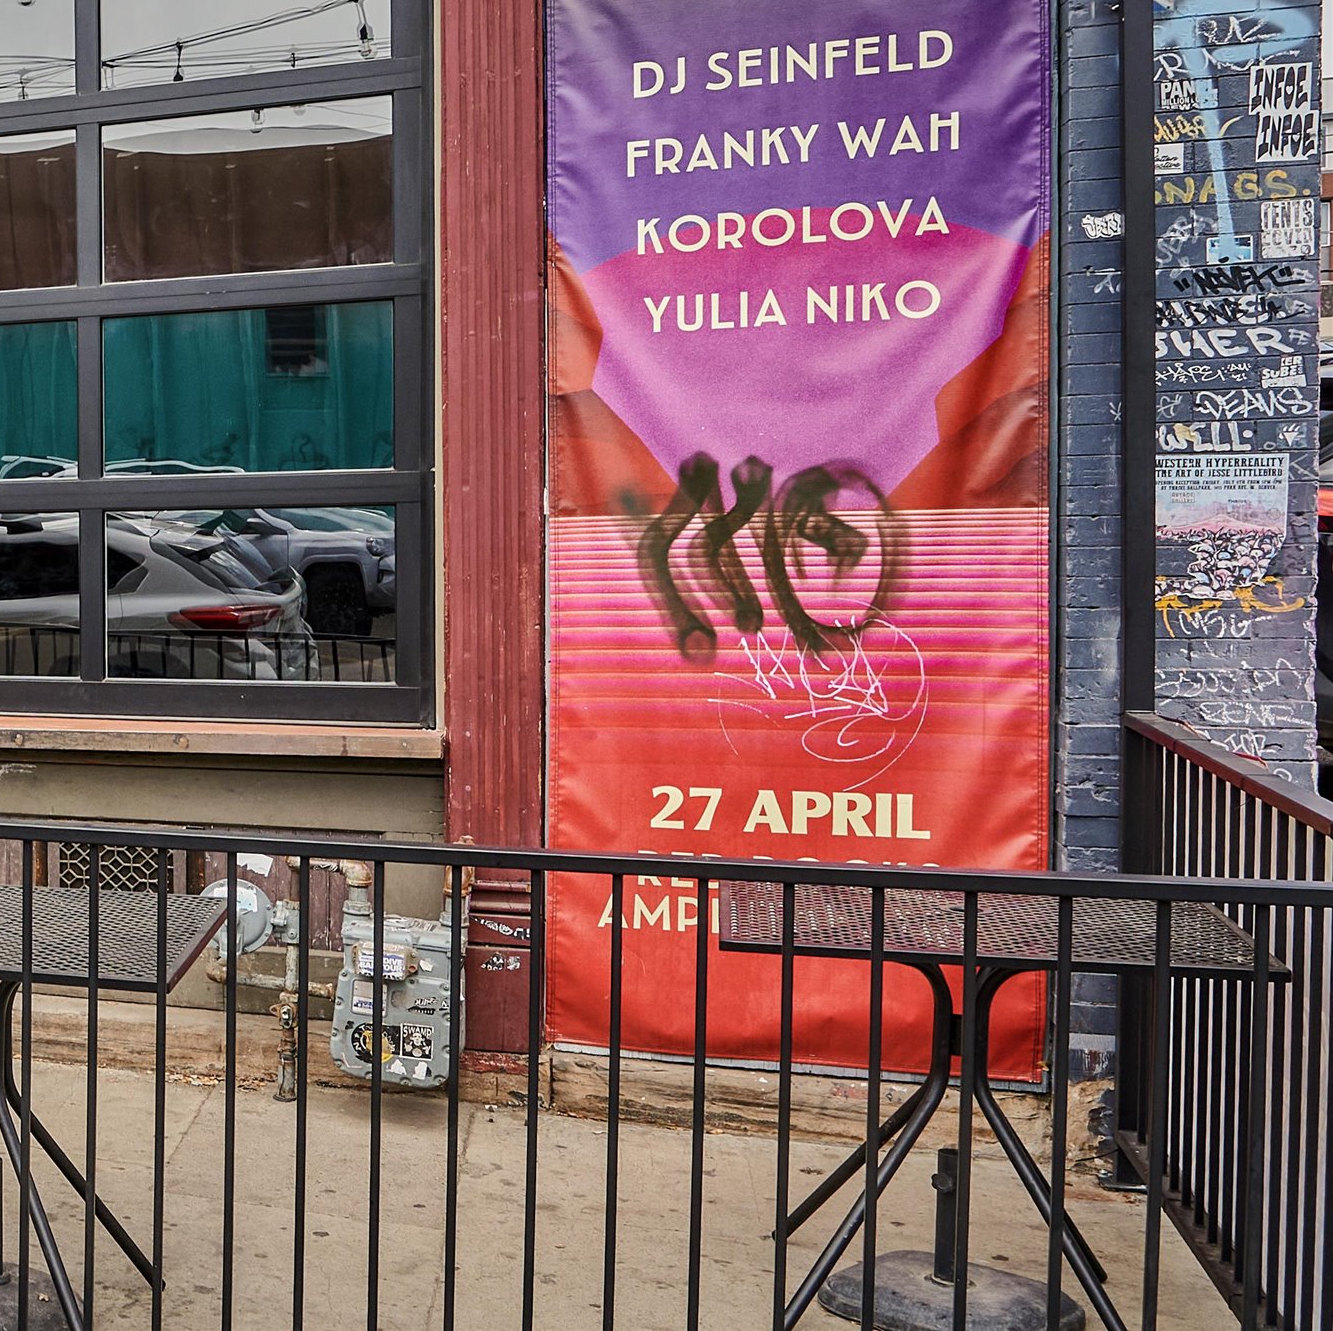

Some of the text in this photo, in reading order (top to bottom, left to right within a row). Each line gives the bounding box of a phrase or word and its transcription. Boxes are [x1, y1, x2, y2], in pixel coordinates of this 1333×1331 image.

[632, 30, 954, 100] DJ SEINFELD
[626, 111, 961, 178] FRANKY WAH
[636, 196, 950, 256] KOROLOVA
[644, 278, 942, 334] YULIA NIKO
[1155, 457, 1284, 468] WESTERN HYPERREALITY
[1156, 468, 1283, 477] THE ART OF JESSE LITTLEBIRD
[649, 785, 931, 840] 27 APRIL
[403, 1025, 433, 1038] SWAMP
